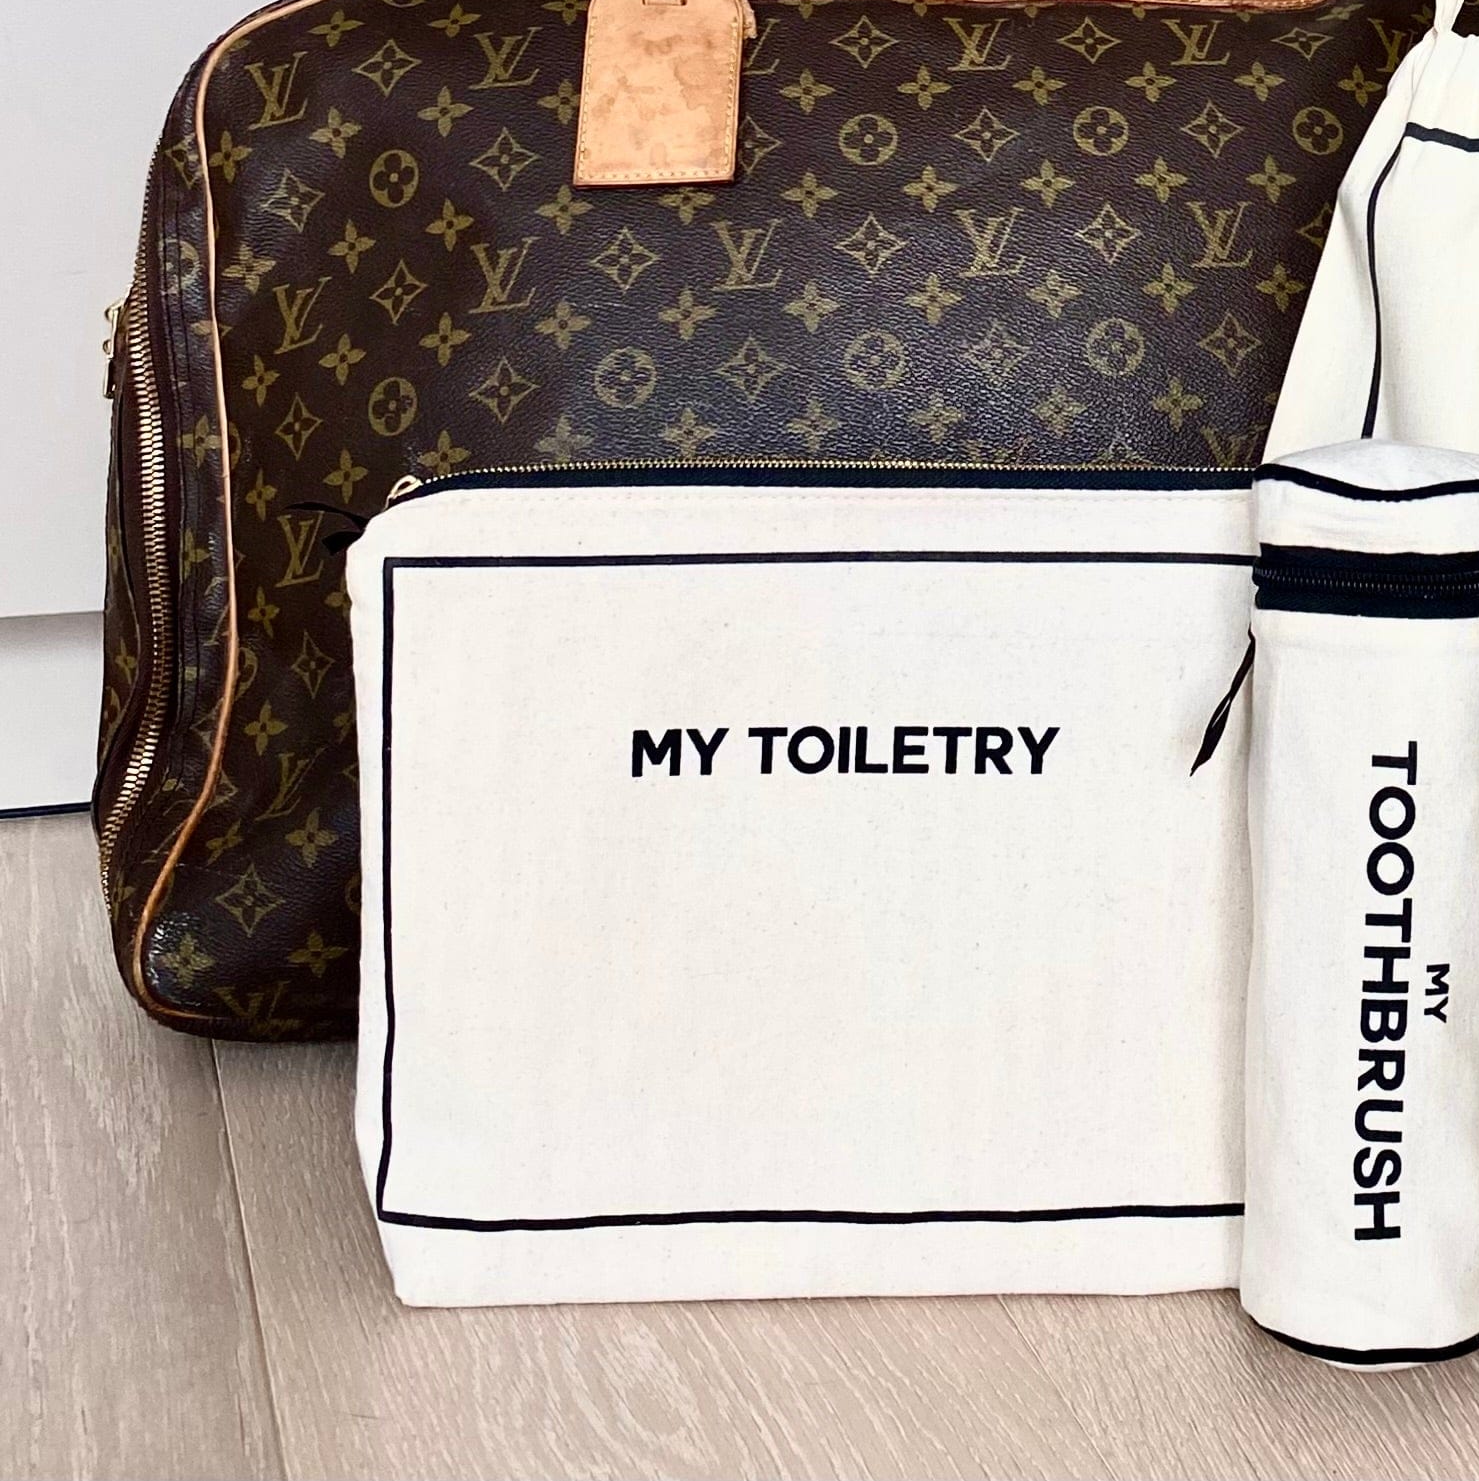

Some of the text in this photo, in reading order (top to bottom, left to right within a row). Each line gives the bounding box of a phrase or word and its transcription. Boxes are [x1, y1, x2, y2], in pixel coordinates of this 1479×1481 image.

[631, 725, 1062, 778] MY TOILETRY
[1353, 740, 1419, 1242] TOOTHBRUSH
[1423, 962, 1451, 1025] MY
